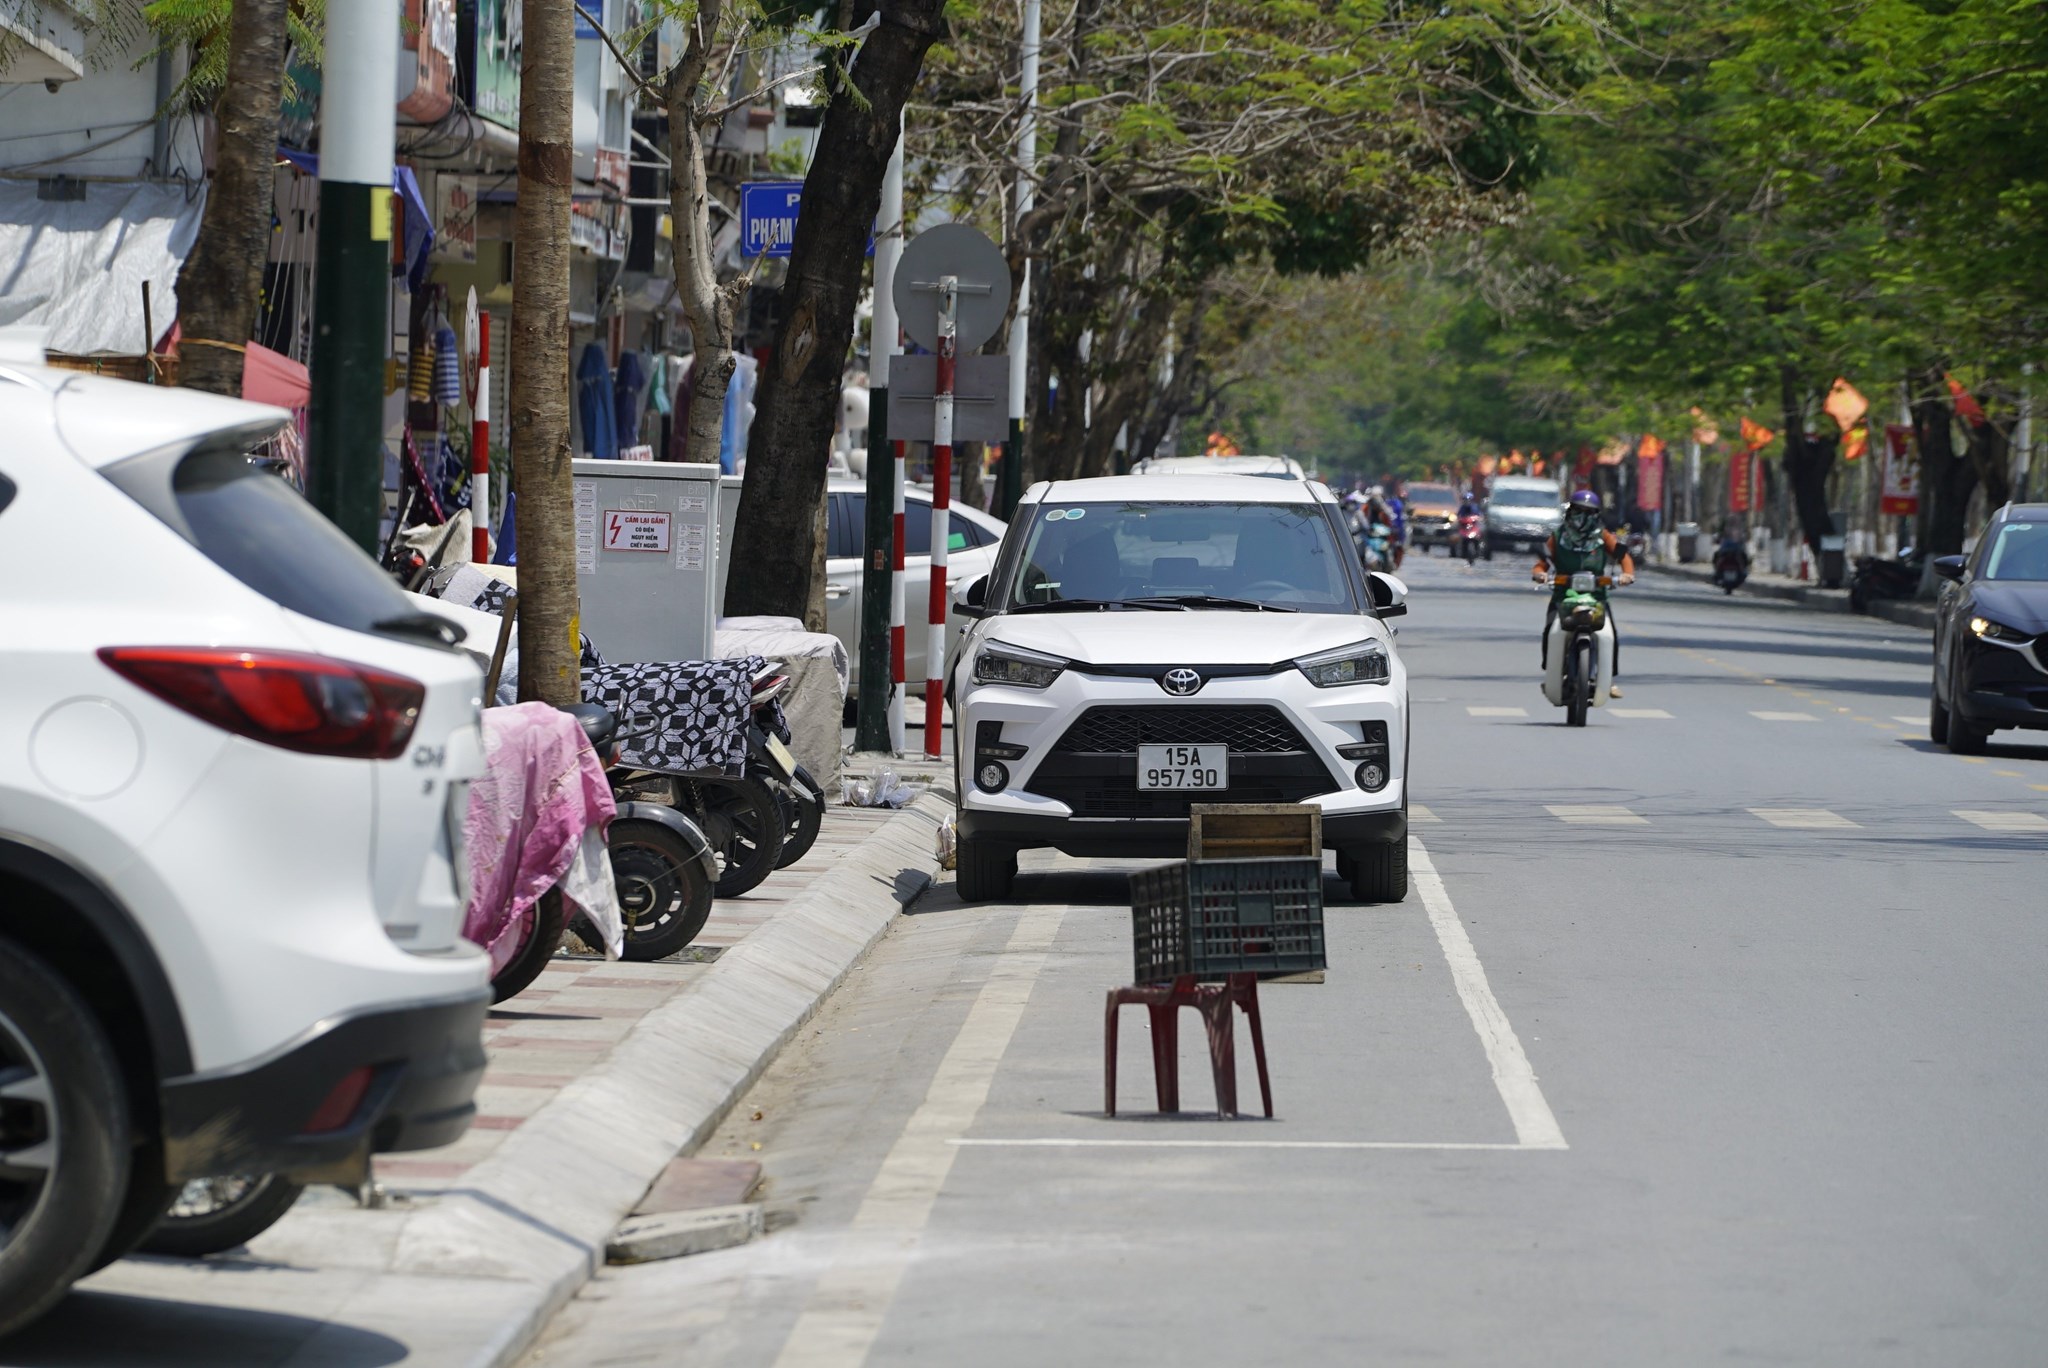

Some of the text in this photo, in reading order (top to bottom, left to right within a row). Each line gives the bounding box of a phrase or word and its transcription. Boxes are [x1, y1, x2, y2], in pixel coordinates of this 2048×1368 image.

[751, 217, 792, 249] PHẠM
[1166, 747, 1201, 766] 15A
[1147, 769, 1217, 787] 957.90
